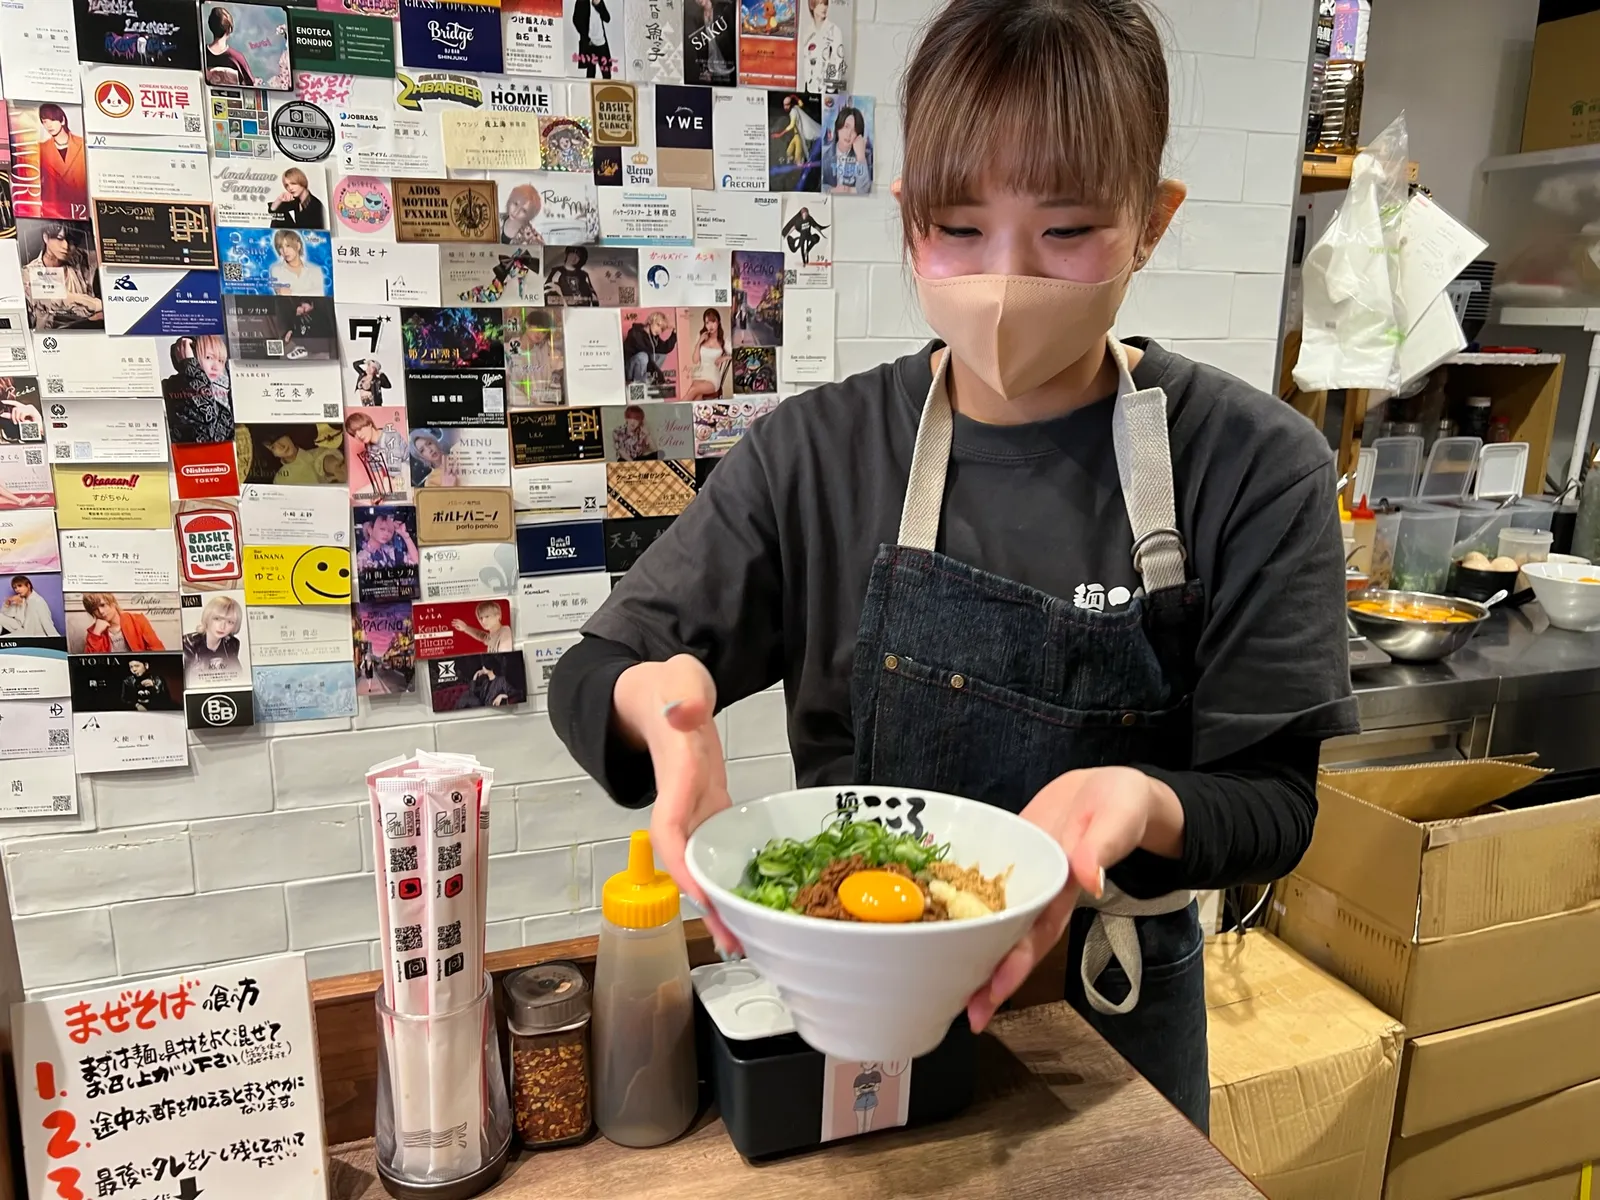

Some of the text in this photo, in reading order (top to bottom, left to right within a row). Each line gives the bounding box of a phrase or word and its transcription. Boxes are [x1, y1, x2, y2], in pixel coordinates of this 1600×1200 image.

[446, 3, 495, 14] OPENING
[296, 26, 332, 37] ENOTECA
[428, 20, 474, 50] Bridge
[691, 16, 729, 51] SAKU
[296, 37, 333, 48] RONDINO
[140, 89, 190, 109] 진짜루
[491, 91, 548, 107] HOMIE
[492, 105, 549, 114] TOKOROZAWA
[599, 101, 630, 112] BASHI
[347, 113, 379, 122] JOBRASS
[598, 112, 632, 122] BURGER
[599, 122, 630, 130] CHANCE
[665, 116, 703, 130] YWE
[279, 125, 329, 140] NOMOUZE
[292, 142, 317, 151] GROUP
[729, 180, 765, 188] RECRUIT
[408, 185, 440, 196] ADIOS
[401, 197, 448, 208] MOTHER
[404, 209, 448, 219] FXXKER
[337, 246, 388, 257] 白銀 セナ
[385, 423, 398, 464] エイト
[459, 438, 492, 447] MENU
[186, 466, 227, 474] Nishiazabu
[92, 493, 130, 501] すがちゃん
[188, 531, 230, 544] BASHI
[189, 542, 234, 554] BURGER
[547, 546, 575, 557] Roxy
[190, 551, 232, 563] CHANCE
[363, 619, 403, 632] PACINO
[418, 623, 449, 634] Kento
[419, 638, 454, 647] Hirano
[90, 1076, 305, 1140] 途中お酢を加えるとまろやかに
[240, 1095, 296, 1115] なります。
[95, 1132, 305, 1197] 最後にタレを少し残しておいて
